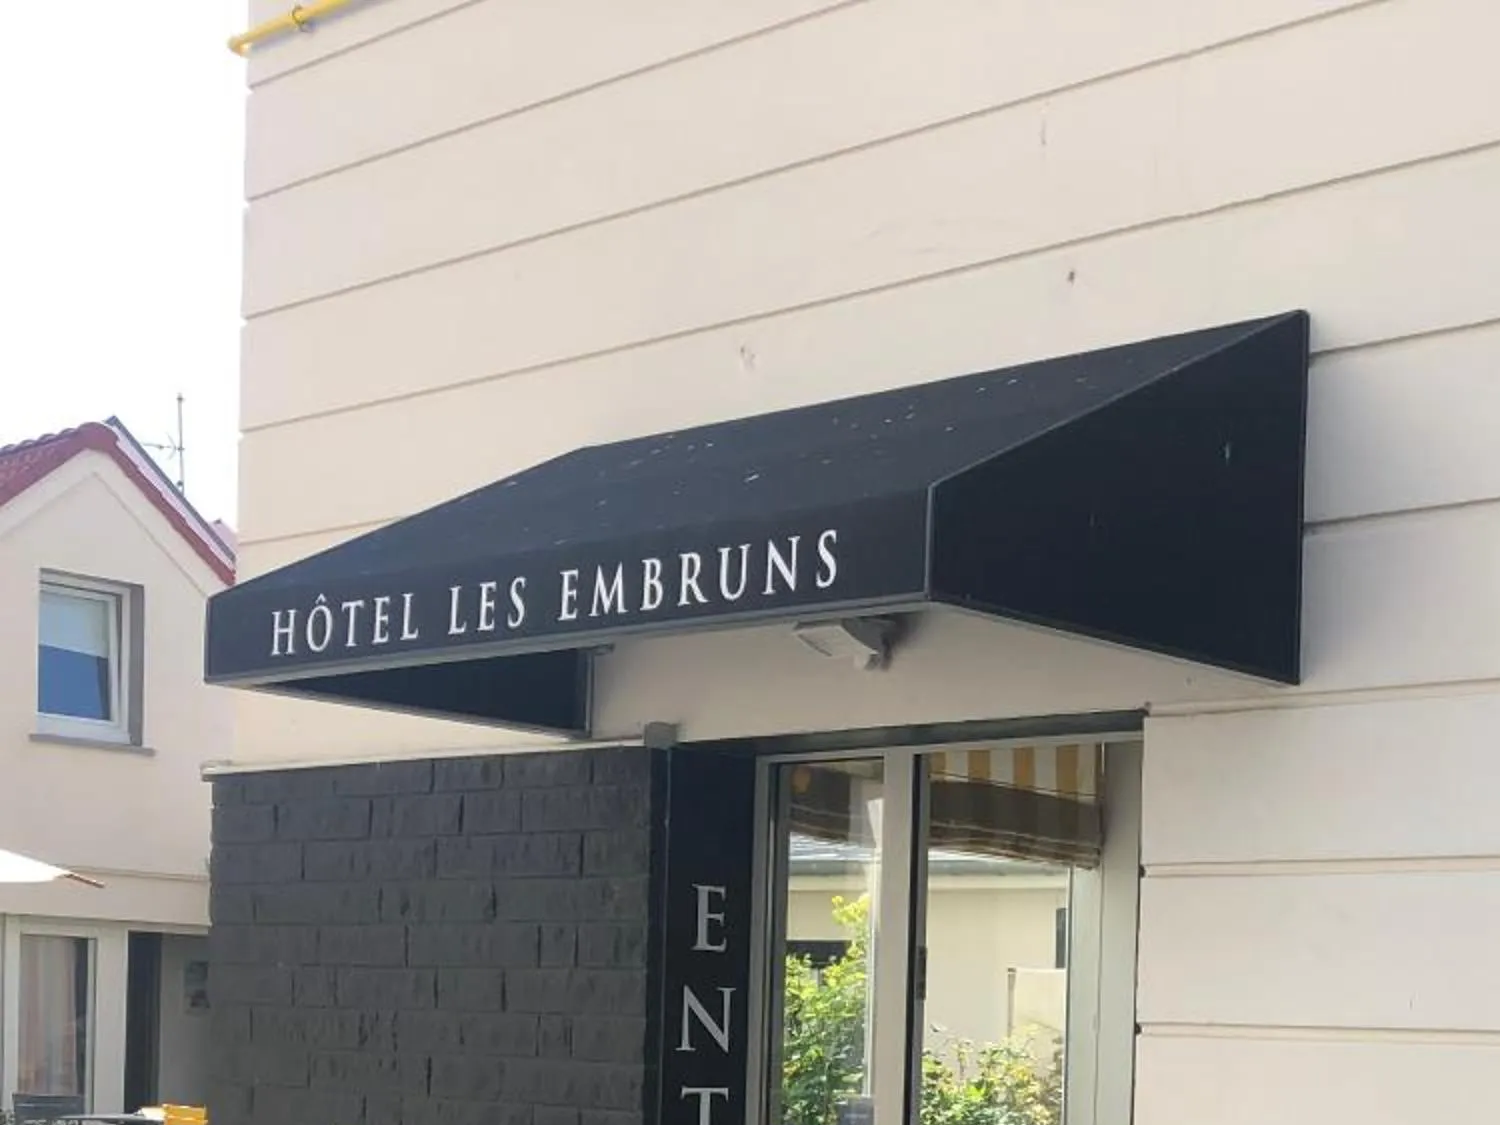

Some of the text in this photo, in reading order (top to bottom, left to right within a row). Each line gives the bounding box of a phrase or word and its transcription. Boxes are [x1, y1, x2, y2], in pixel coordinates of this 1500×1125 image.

[270, 529, 838, 656] HÔTEL LES EMBRUNS
